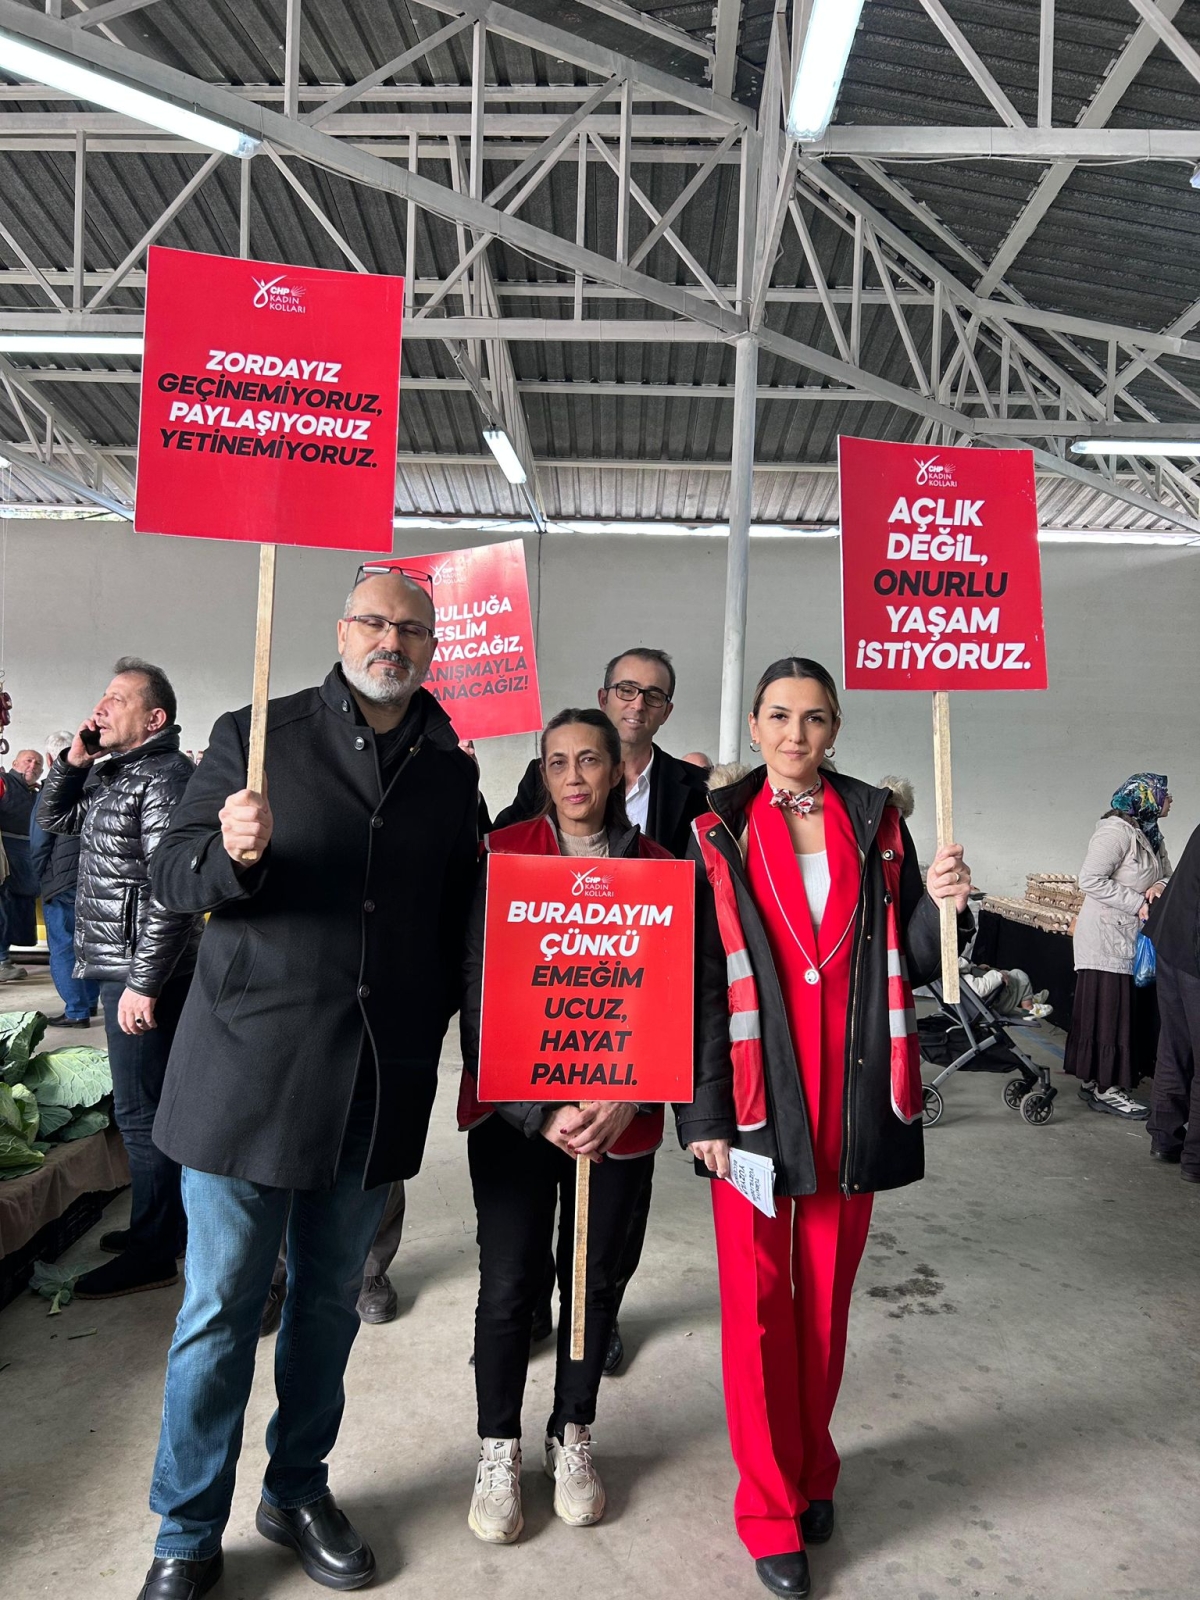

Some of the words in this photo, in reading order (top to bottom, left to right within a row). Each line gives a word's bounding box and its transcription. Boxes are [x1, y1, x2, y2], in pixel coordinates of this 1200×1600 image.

[270, 286, 290, 295] CHP
[270, 295, 300, 304] KADIN
[270, 303, 306, 313] KOLLARI
[206, 350, 341, 383] ZORDAYIZ
[158, 373, 382, 416] GEÇİNEMİYORUZ,
[169, 402, 372, 440] PAYLAŞIYORUZ
[161, 429, 377, 468] YETİNEMİYORUZ.
[928, 465, 944, 473] CHP
[928, 472, 952, 480] KADIN
[928, 479, 958, 487] KOLLARI
[888, 497, 986, 532] AÇLIK
[874, 569, 1008, 598] ONURLU
[435, 619, 487, 643] ESLİM
[886, 606, 1000, 641] YAŞAM
[432, 635, 524, 662] AYACAĞIZ,
[424, 656, 527, 683] ANIŞMAYLA
[432, 675, 529, 701] ANACAĞIZ!
[585, 876, 601, 884] CHP
[507, 901, 673, 926] BURADAYIM
[540, 928, 640, 961] ÇÜNKÜ
[532, 961, 645, 987] EMEĞİM
[545, 998, 627, 1022] UCUZ,
[540, 1031, 632, 1052] HAYAT
[531, 1064, 638, 1085] PAHALI.
